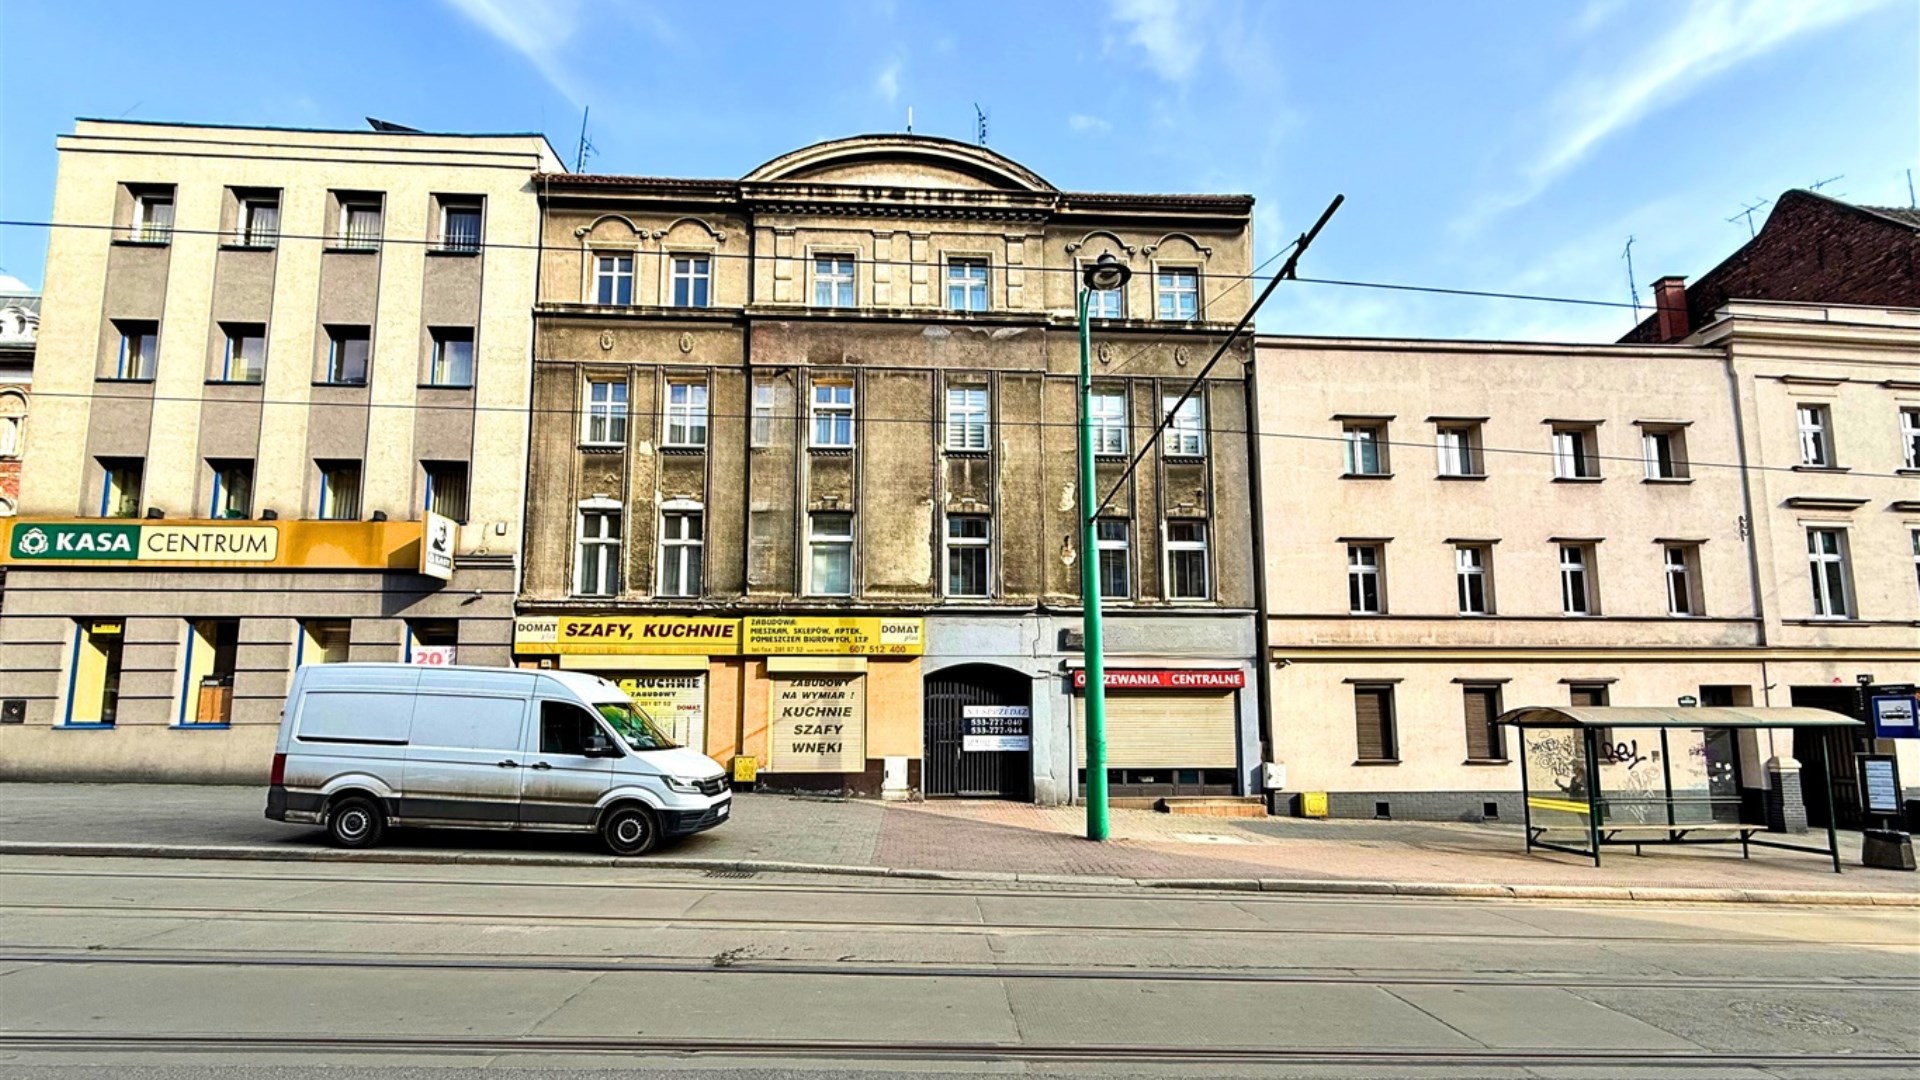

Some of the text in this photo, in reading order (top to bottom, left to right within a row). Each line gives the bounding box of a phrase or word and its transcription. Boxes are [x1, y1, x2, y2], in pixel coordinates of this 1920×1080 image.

[56, 532, 268, 553] KASA CENTRUM
[518, 623, 557, 632] DOMAT
[565, 623, 735, 640] SZAFY, KUCHNIE
[882, 625, 919, 633] DOMAT
[849, 645, 864, 653] 607
[869, 645, 885, 653] 512
[889, 645, 906, 653] 400
[636, 678, 700, 688] KUCHNIE
[1077, 674, 1241, 685] OZEWANIA CENTRALNE
[782, 691, 797, 699] NA
[802, 691, 845, 699] WYMIAR
[782, 706, 853, 717] KUCHNIE
[793, 724, 843, 735] SZAFY
[792, 742, 843, 756] WNĘKI
